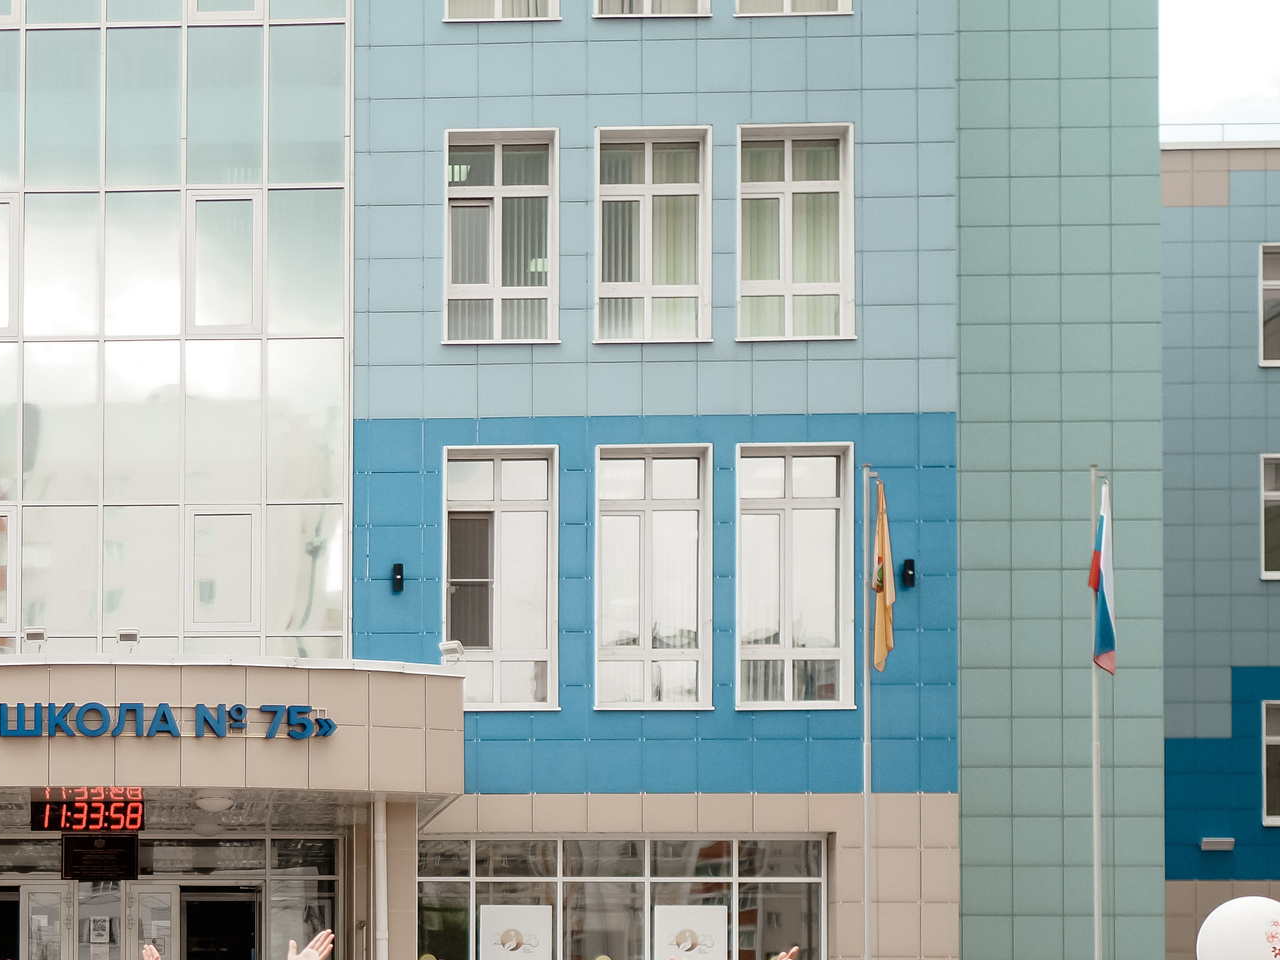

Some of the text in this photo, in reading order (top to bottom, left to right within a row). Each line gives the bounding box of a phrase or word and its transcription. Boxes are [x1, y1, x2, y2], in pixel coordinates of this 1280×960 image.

[195, 703, 247, 738] №
[260, 704, 338, 740] 75»
[44, 802, 143, 830] 11:33:58
